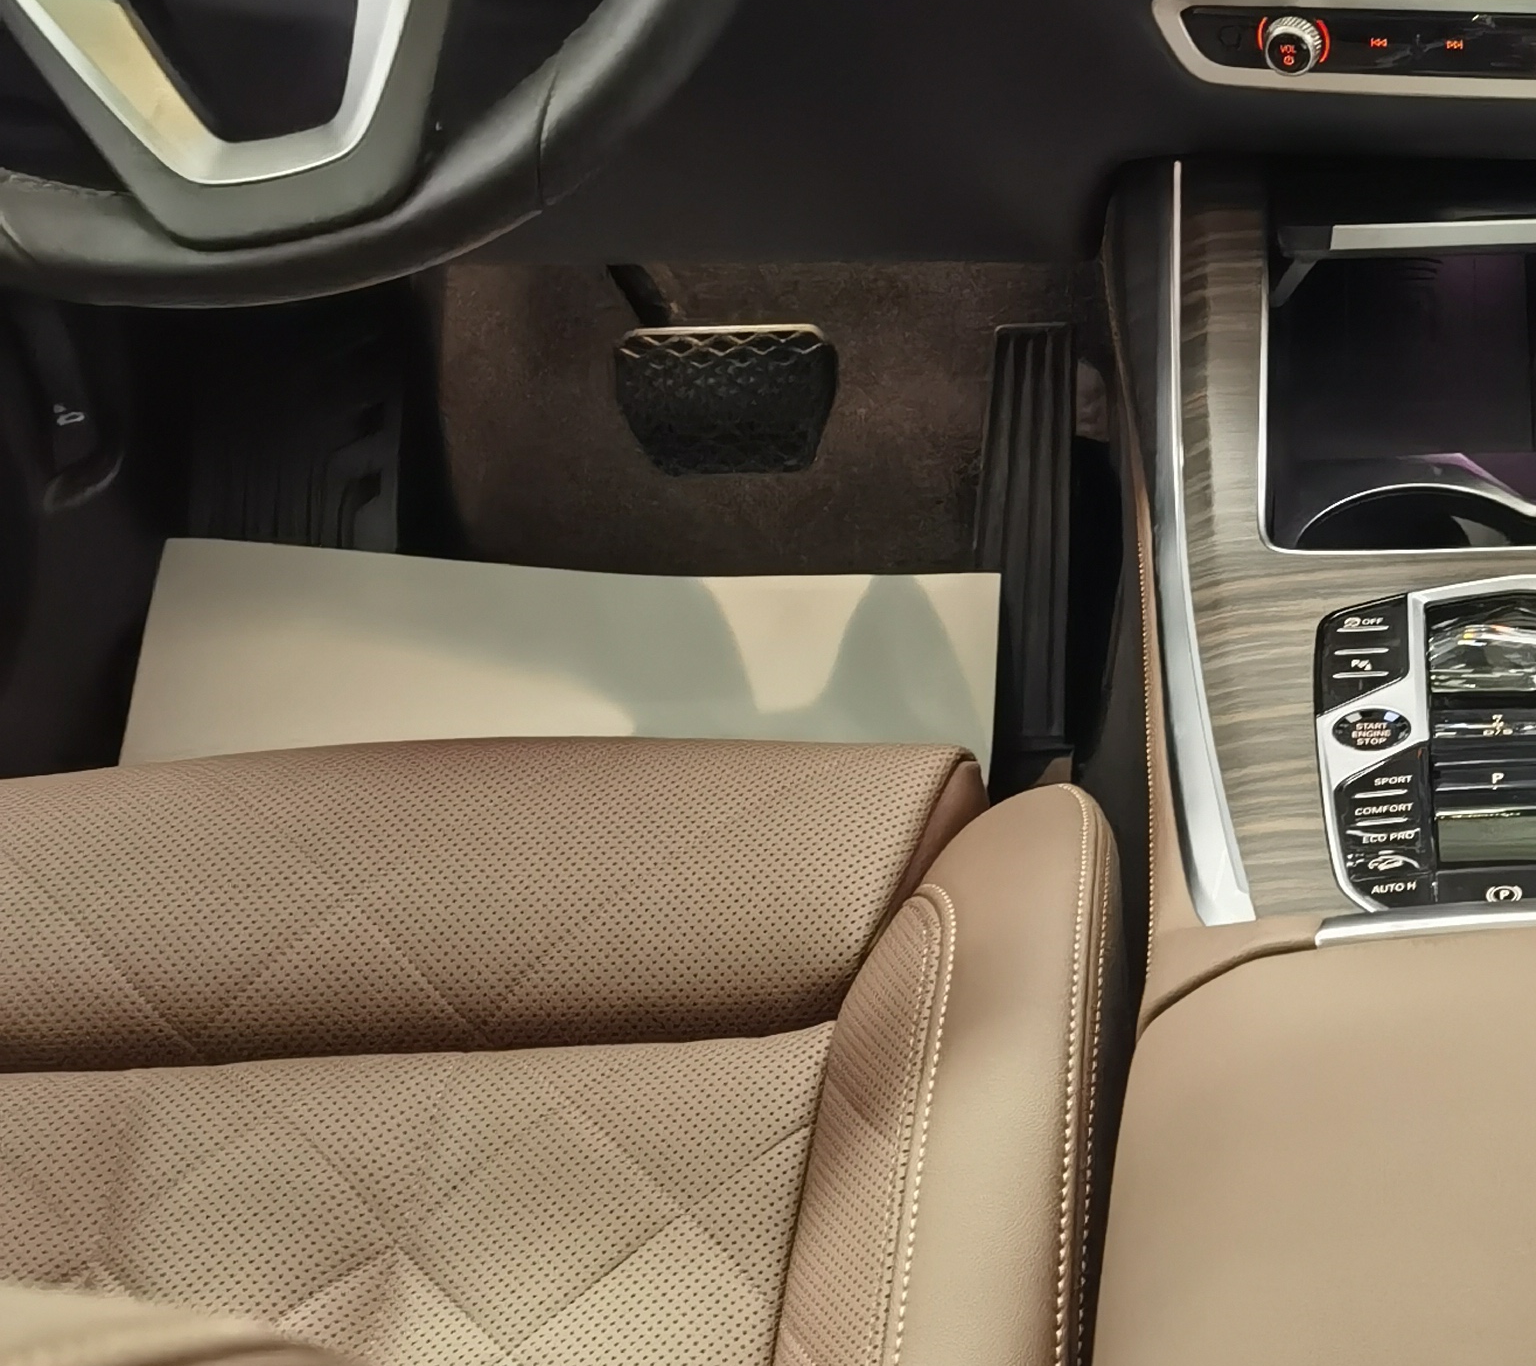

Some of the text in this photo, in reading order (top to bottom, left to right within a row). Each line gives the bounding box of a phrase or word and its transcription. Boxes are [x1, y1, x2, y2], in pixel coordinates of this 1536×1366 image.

[1279, 44, 1297, 54] VOL
[1361, 617, 1384, 625] OFF
[1355, 722, 1388, 731] START
[1351, 729, 1392, 739] ENGINE
[1356, 737, 1388, 746] STOP
[1374, 774, 1413, 786] SPORT
[1354, 802, 1414, 816] COMFORT
[1362, 832, 1415, 844] ECO PRO
[1371, 880, 1417, 895] AUTO H
